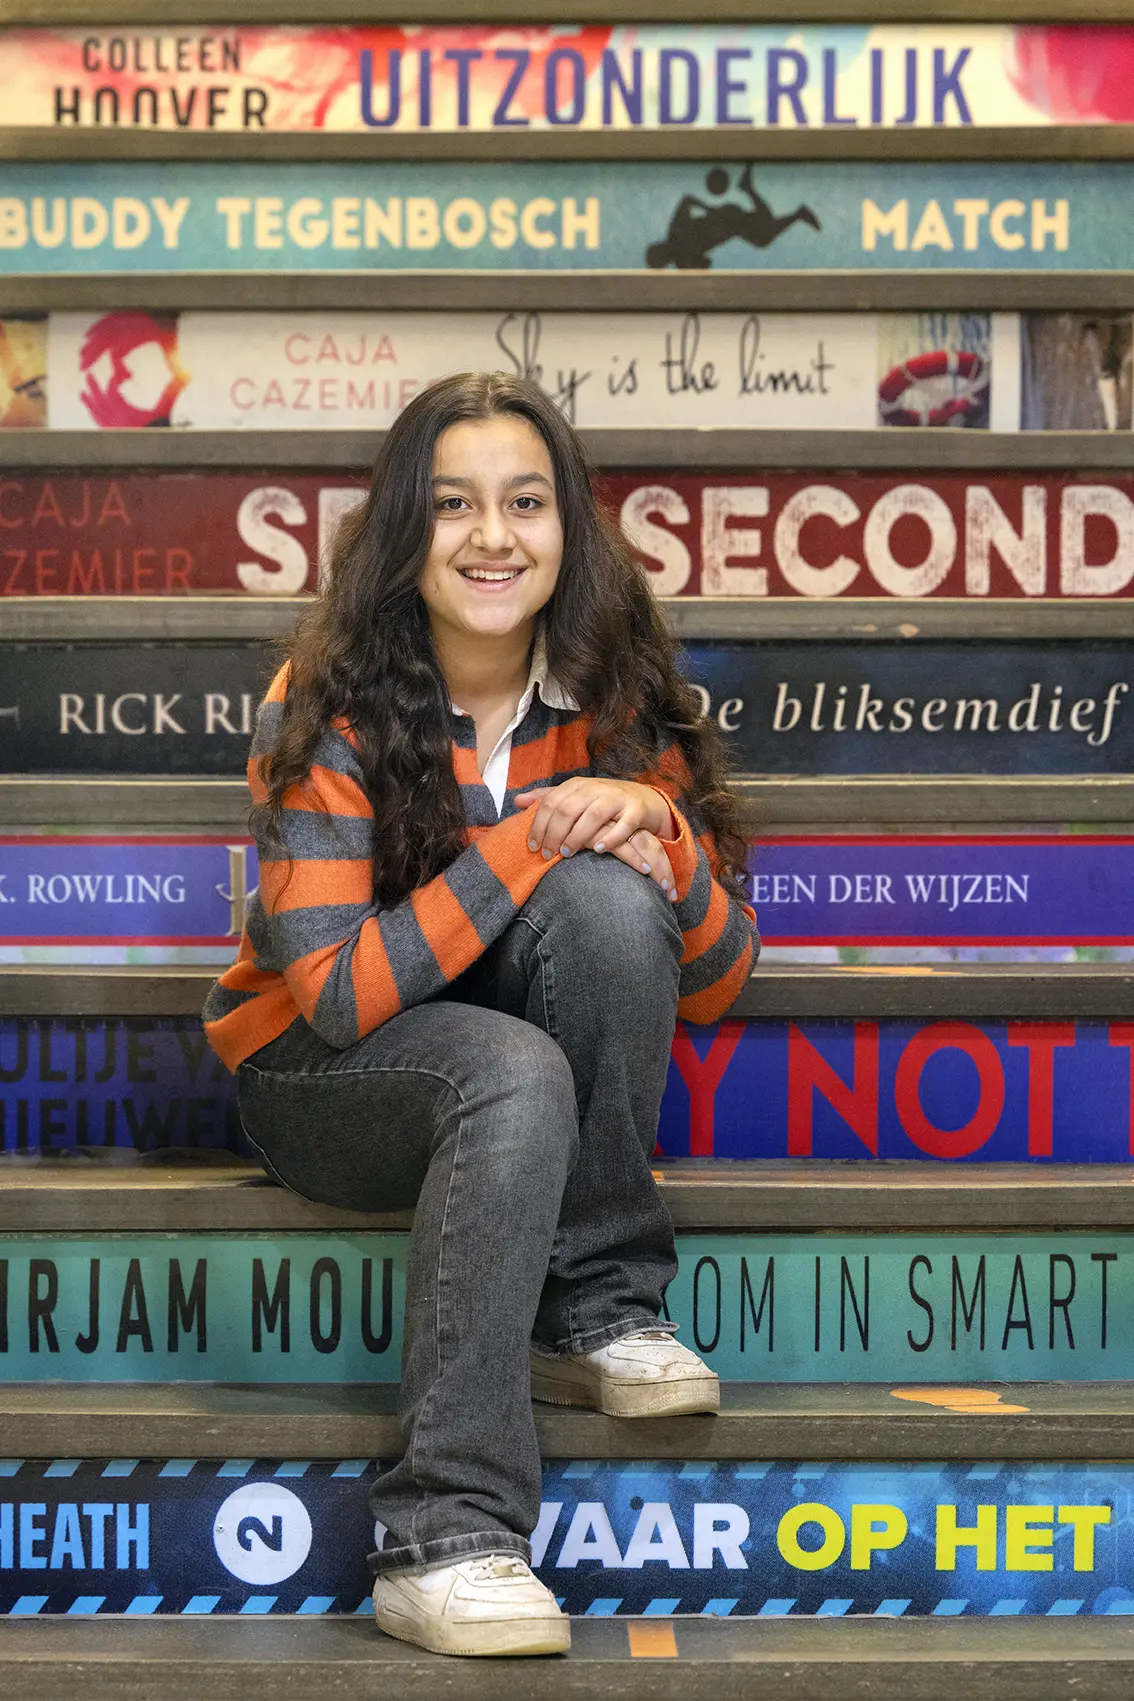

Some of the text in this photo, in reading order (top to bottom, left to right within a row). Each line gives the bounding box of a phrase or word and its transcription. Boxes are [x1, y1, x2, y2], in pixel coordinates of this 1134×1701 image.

[82, 37, 241, 73] COLLEEN
[54, 86, 269, 127] HOOVER
[358, 47, 974, 127] UITZONDERLIJK
[0, 197, 600, 249] BUDDY TEGENBOSCH
[861, 199, 1070, 251] MATCH
[284, 333, 398, 365] CAJA
[607, 356, 639, 395] is
[662, 315, 719, 393] the
[738, 316, 834, 395] limit
[230, 378, 438, 412] CAZEMIE
[0, 481, 131, 527] CAJA
[620, 484, 1134, 598] SECOND
[3, 549, 193, 595] ZEMIER
[59, 694, 186, 735] RICK
[772, 682, 1129, 746] bliksemdief
[28, 874, 186, 904] ROWLING
[736, 874, 1030, 912] EEN DER WIJZEN
[652, 1021, 747, 1157] Y
[787, 1021, 1076, 1158] NOT
[252, 1257, 394, 1354] MOU
[661, 1253, 1118, 1354] OM IN SMART
[776, 1502, 908, 1570] OP
[936, 1504, 1111, 1571] HET
